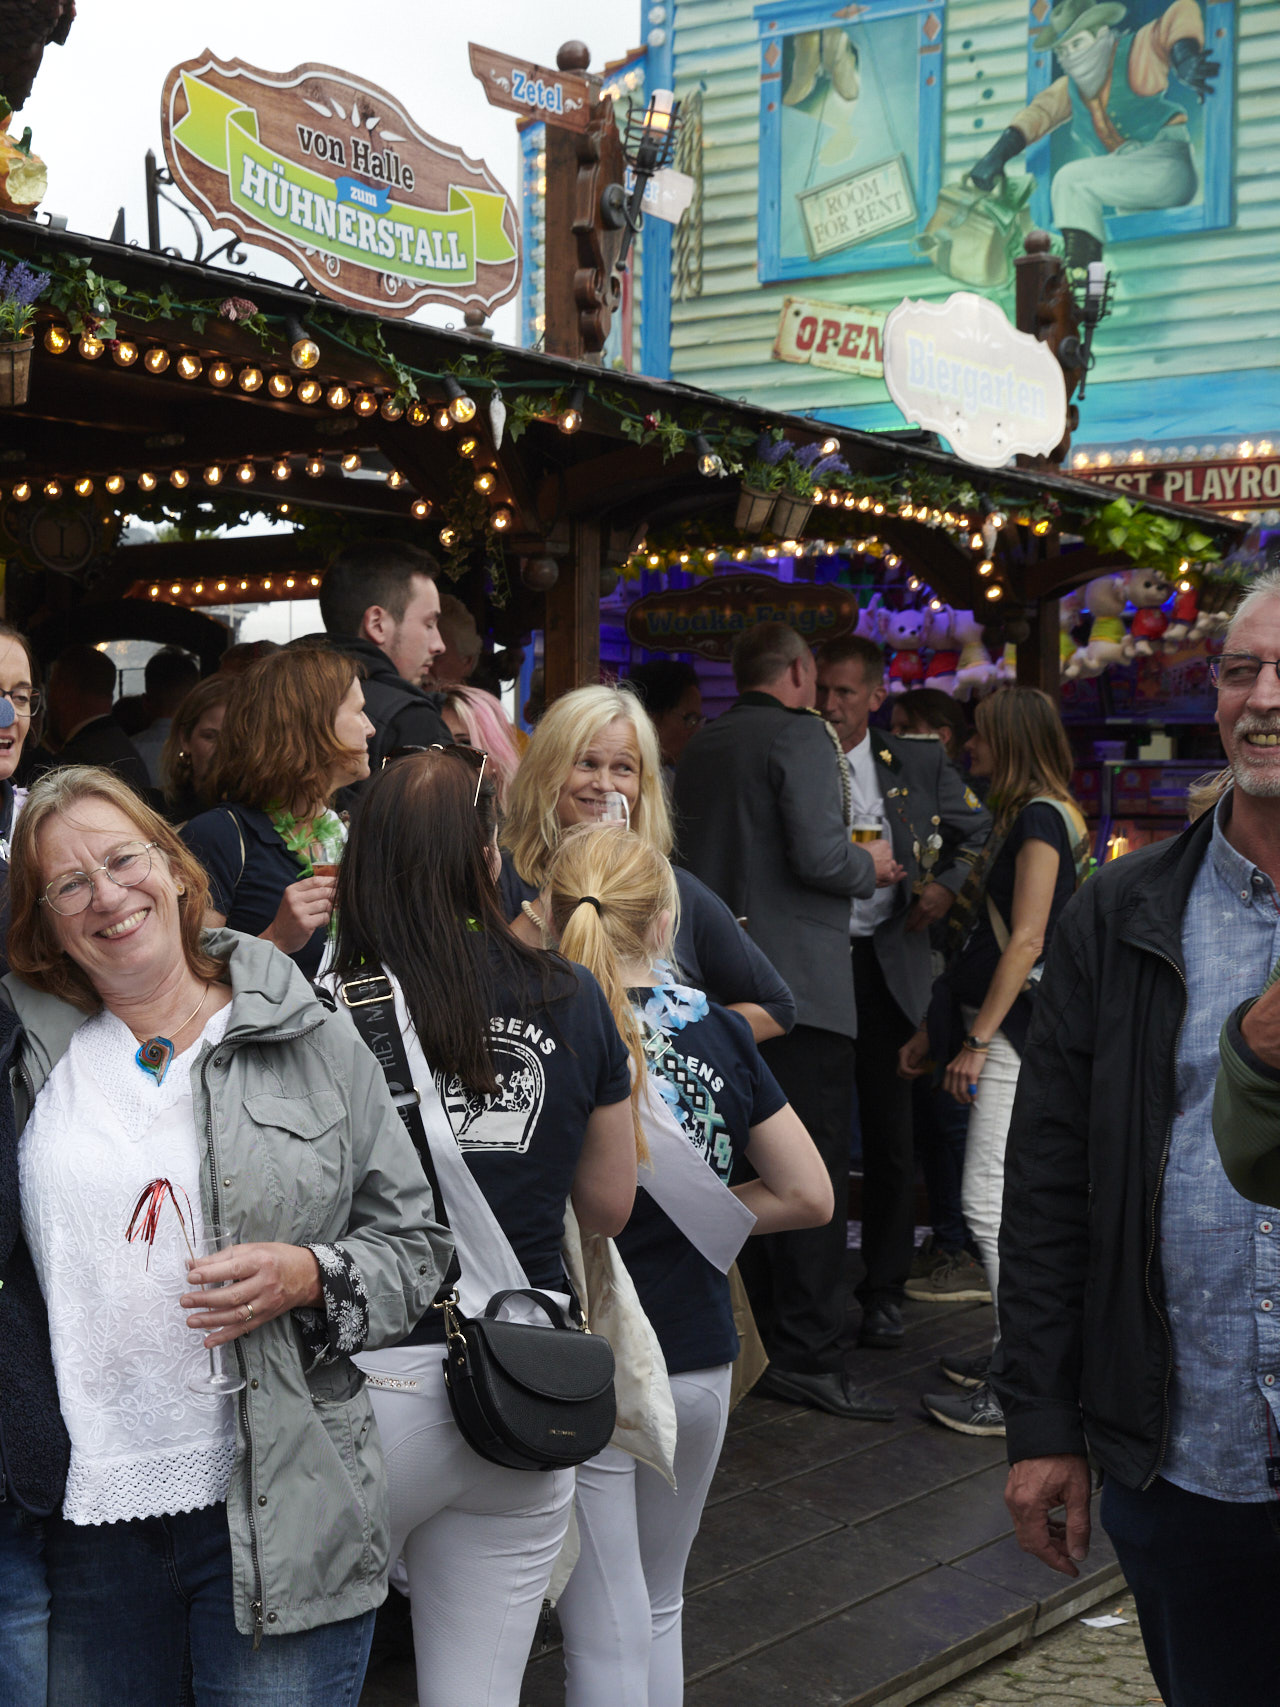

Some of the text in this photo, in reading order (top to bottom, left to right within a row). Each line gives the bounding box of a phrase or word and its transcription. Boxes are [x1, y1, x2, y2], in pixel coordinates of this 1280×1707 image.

[511, 70, 564, 115] Zetel
[297, 125, 415, 192] von Halle
[241, 154, 467, 271] HÜHNERSTALL
[349, 184, 378, 208] zum
[814, 190, 902, 243] FOR RENT
[826, 178, 880, 216] ROOM
[907, 333, 1047, 421] Biergarten
[368, 1030, 397, 1068] HEY
